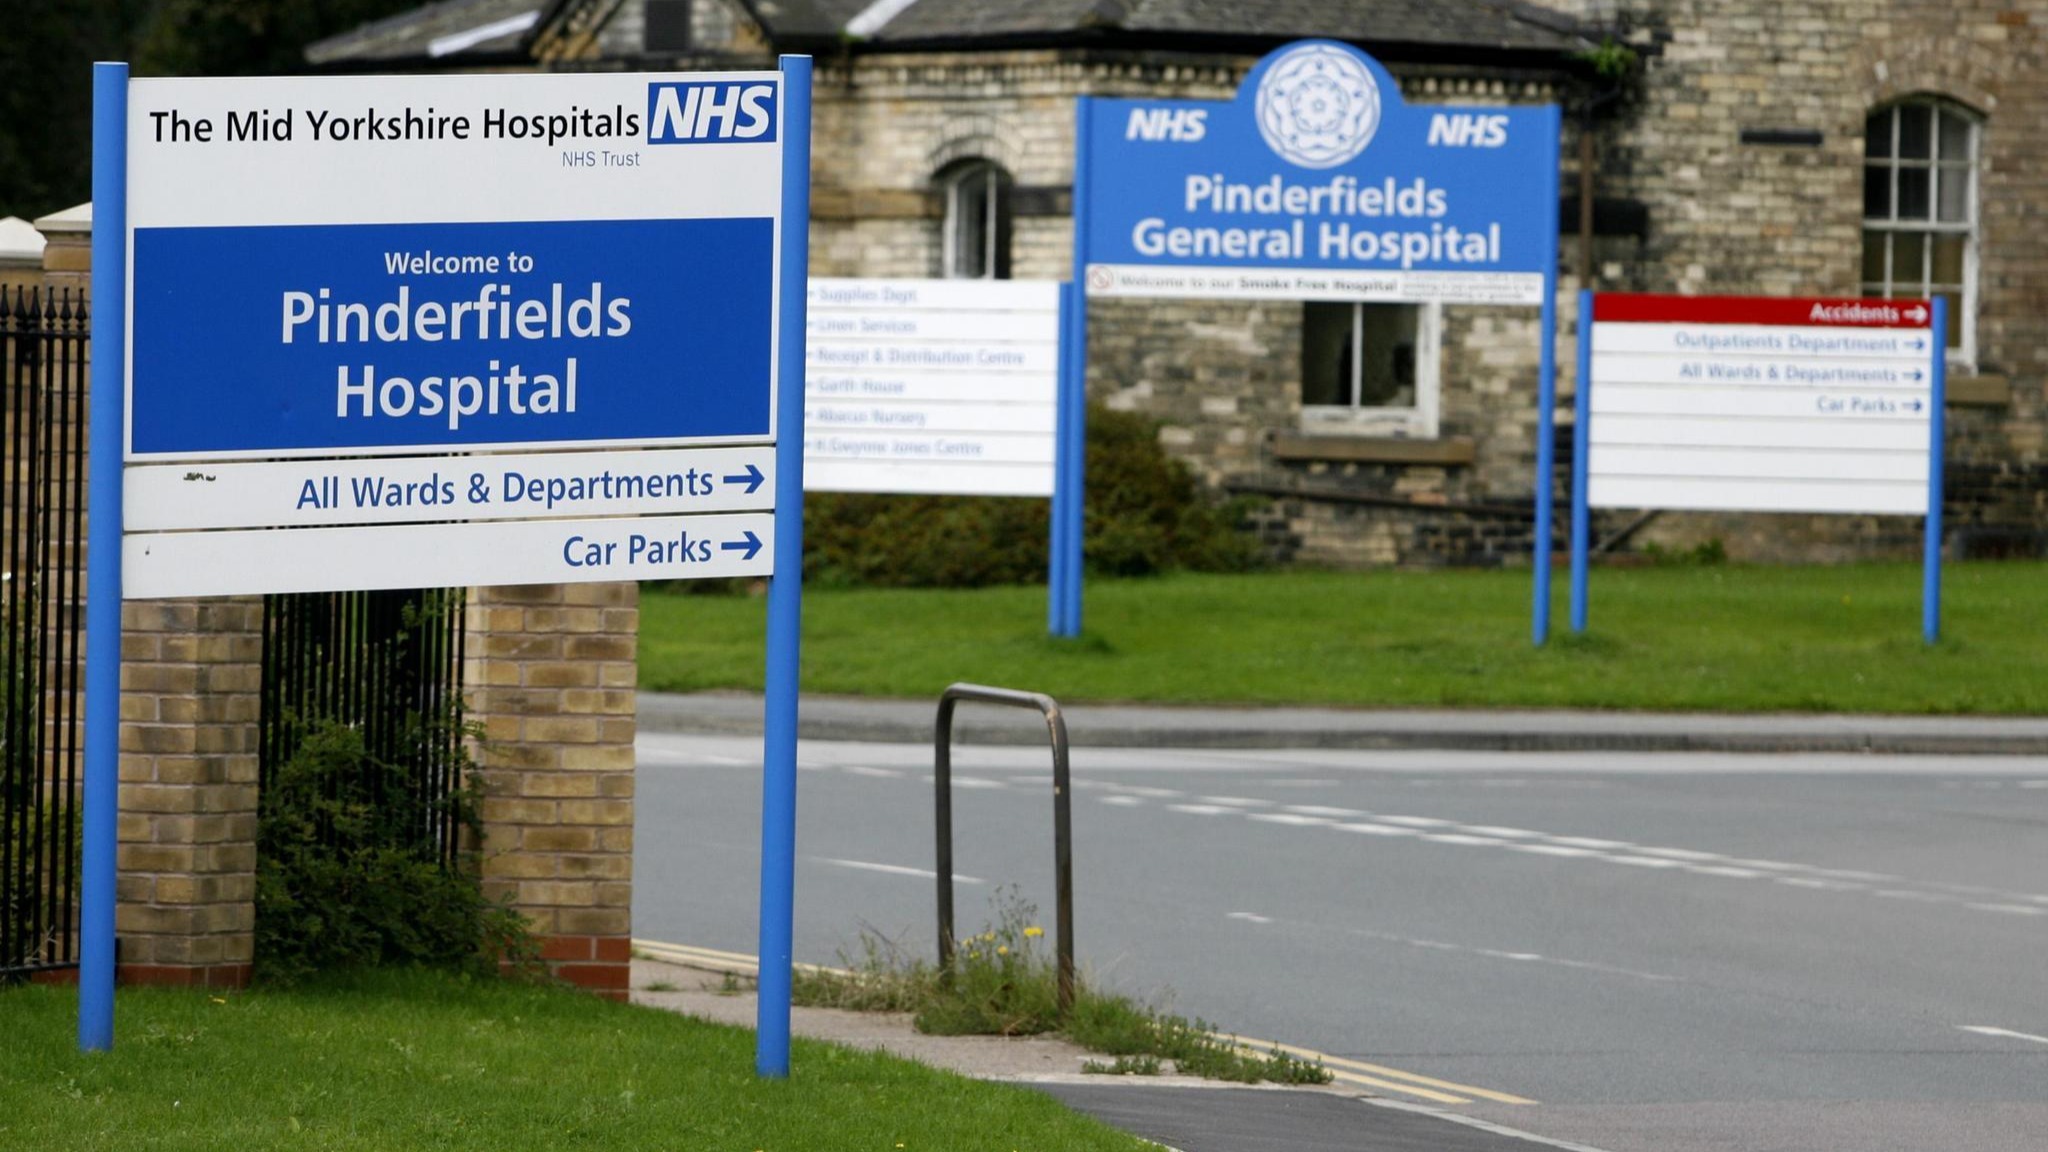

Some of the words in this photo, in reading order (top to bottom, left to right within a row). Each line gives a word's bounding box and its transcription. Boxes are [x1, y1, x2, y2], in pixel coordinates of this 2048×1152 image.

[149, 110, 214, 143] The
[225, 107, 293, 142] Mid
[305, 104, 471, 141] Yorkshire
[483, 104, 640, 146] Hospitals
[649, 85, 774, 140] NHS
[1126, 108, 1207, 142] NHS
[1427, 114, 1509, 147] NHS
[561, 151, 596, 167] NHS
[601, 150, 641, 167] Trust
[1185, 174, 1448, 217] Pinderfields
[1132, 217, 1304, 259] General
[1318, 223, 1501, 268] Hospital
[384, 251, 500, 275] Welcome
[506, 251, 534, 274] to
[1119, 275, 1186, 289] Welcome
[1191, 277, 1206, 289] to
[1211, 279, 1235, 290] our
[1240, 276, 1290, 291] Smoke
[1296, 278, 1328, 292] Free
[1333, 278, 1398, 295] Hospital
[281, 282, 632, 343] Pinderfields
[861, 318, 917, 333] Services
[1809, 303, 1899, 321] Accidents
[1674, 331, 1783, 350] Outpatients
[1789, 334, 1898, 353] Department
[1680, 362, 1703, 379] All
[1707, 363, 1762, 380] Wards
[1769, 364, 1779, 380] &
[1785, 365, 1897, 384] Departments
[336, 357, 578, 430] Hospital
[1816, 396, 1844, 412] Car
[1851, 397, 1896, 413] Parks
[296, 476, 339, 510] All
[352, 474, 456, 507] Wards
[468, 472, 491, 504] &
[503, 467, 715, 509] Departments
[562, 534, 617, 567] Car
[628, 531, 713, 564] Parks
